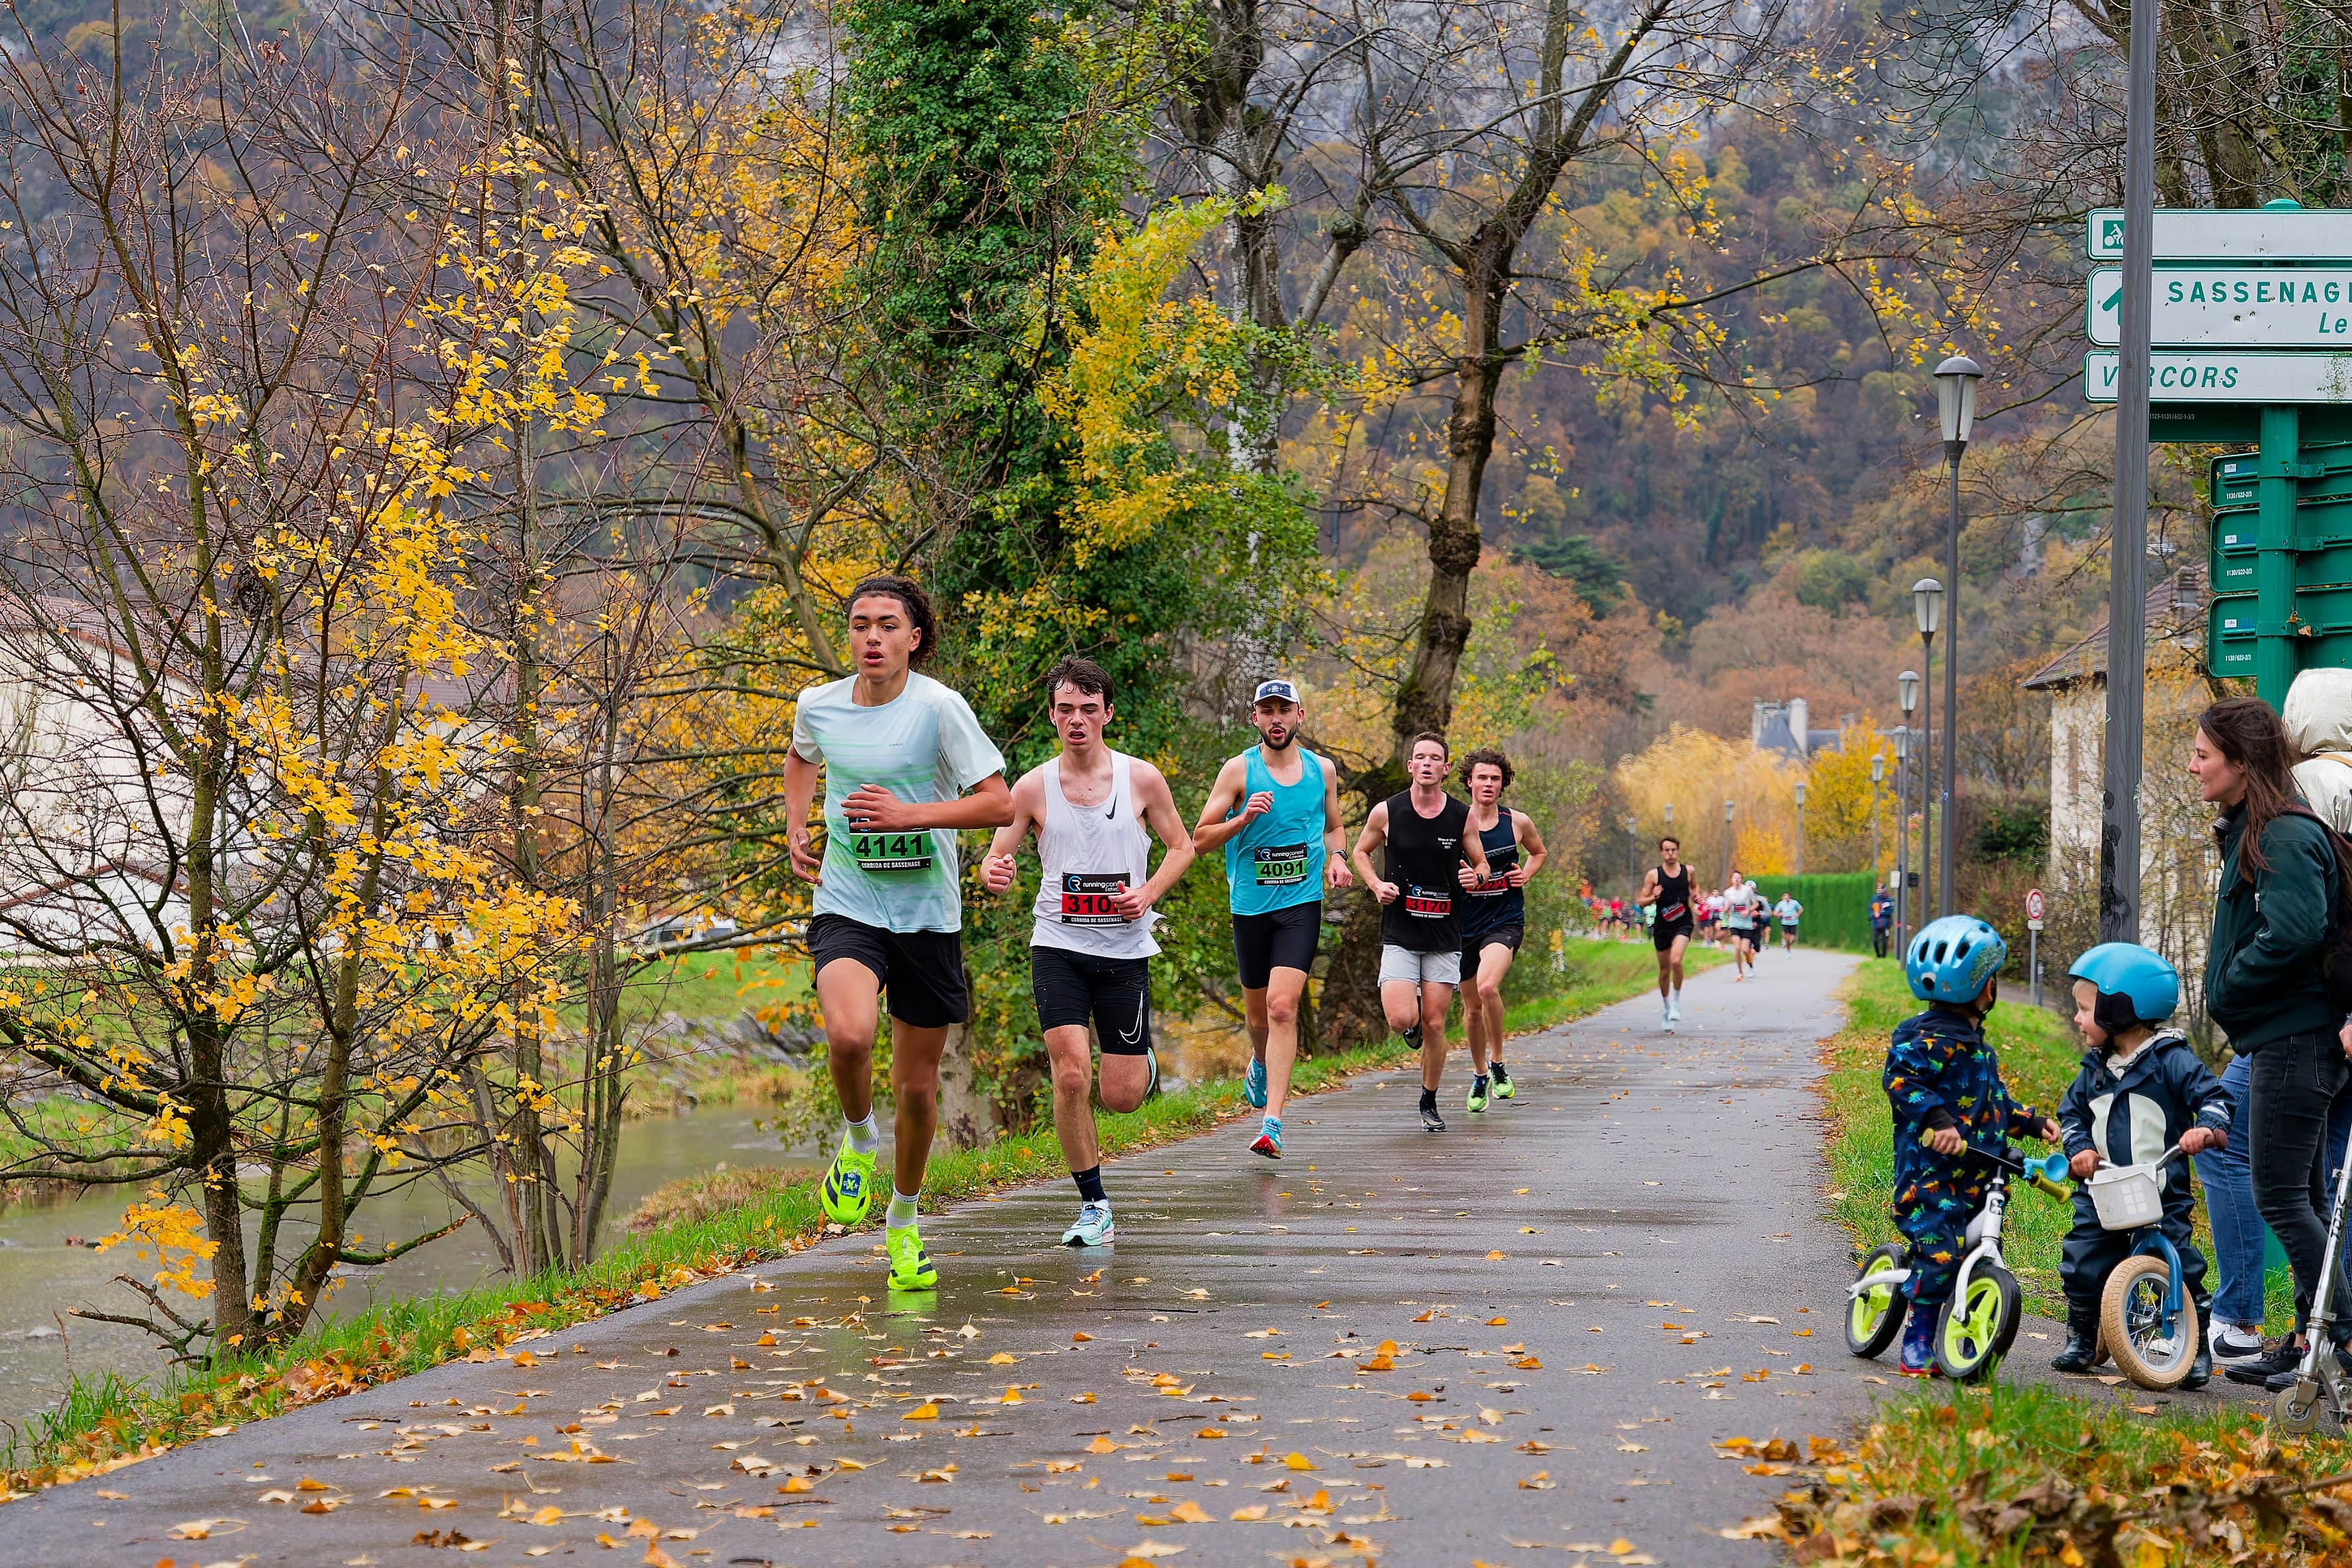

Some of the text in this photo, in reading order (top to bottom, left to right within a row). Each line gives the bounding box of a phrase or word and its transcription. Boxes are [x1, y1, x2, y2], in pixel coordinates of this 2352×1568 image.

[2168, 281, 2352, 303] SASSENAG
[2103, 366, 2238, 388] VCORS
[856, 834, 922, 857] 4141
[1260, 860, 1303, 877] 4091
[1067, 896, 1119, 913] 310
[1409, 898, 1448, 913] 3170
